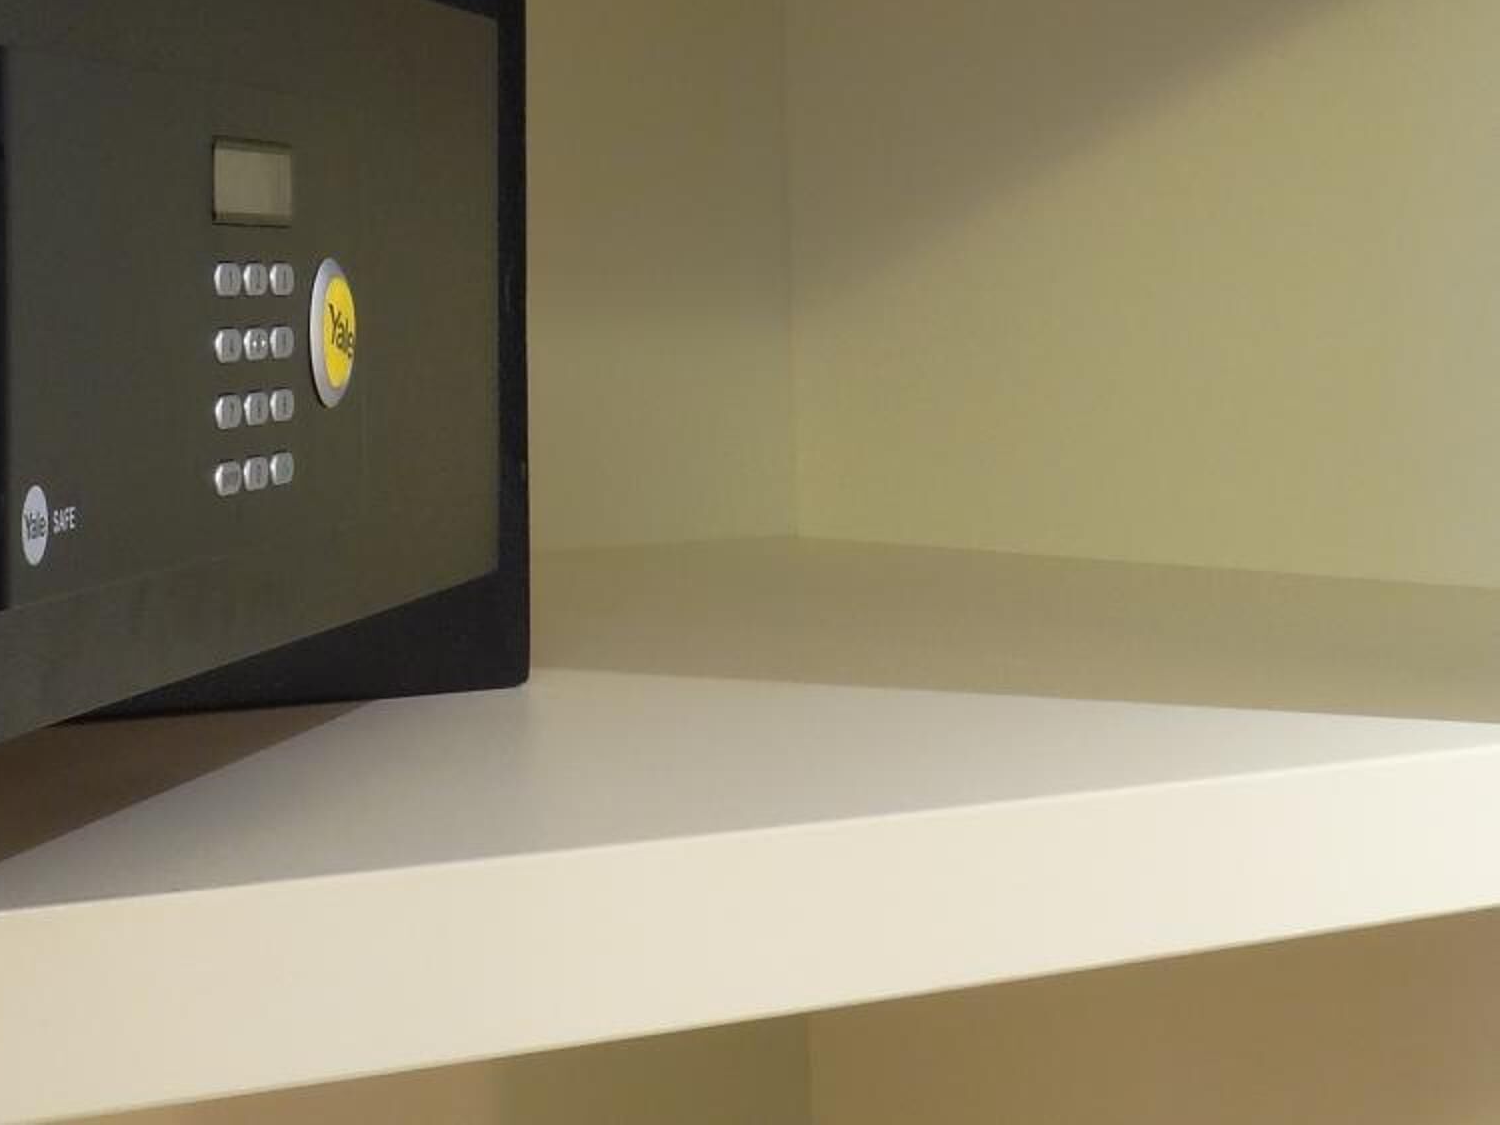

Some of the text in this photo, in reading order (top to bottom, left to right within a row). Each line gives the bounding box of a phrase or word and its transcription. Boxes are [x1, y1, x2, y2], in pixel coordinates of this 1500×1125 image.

[328, 302, 354, 359] Yale
[23, 506, 76, 541] Yale SAFE
